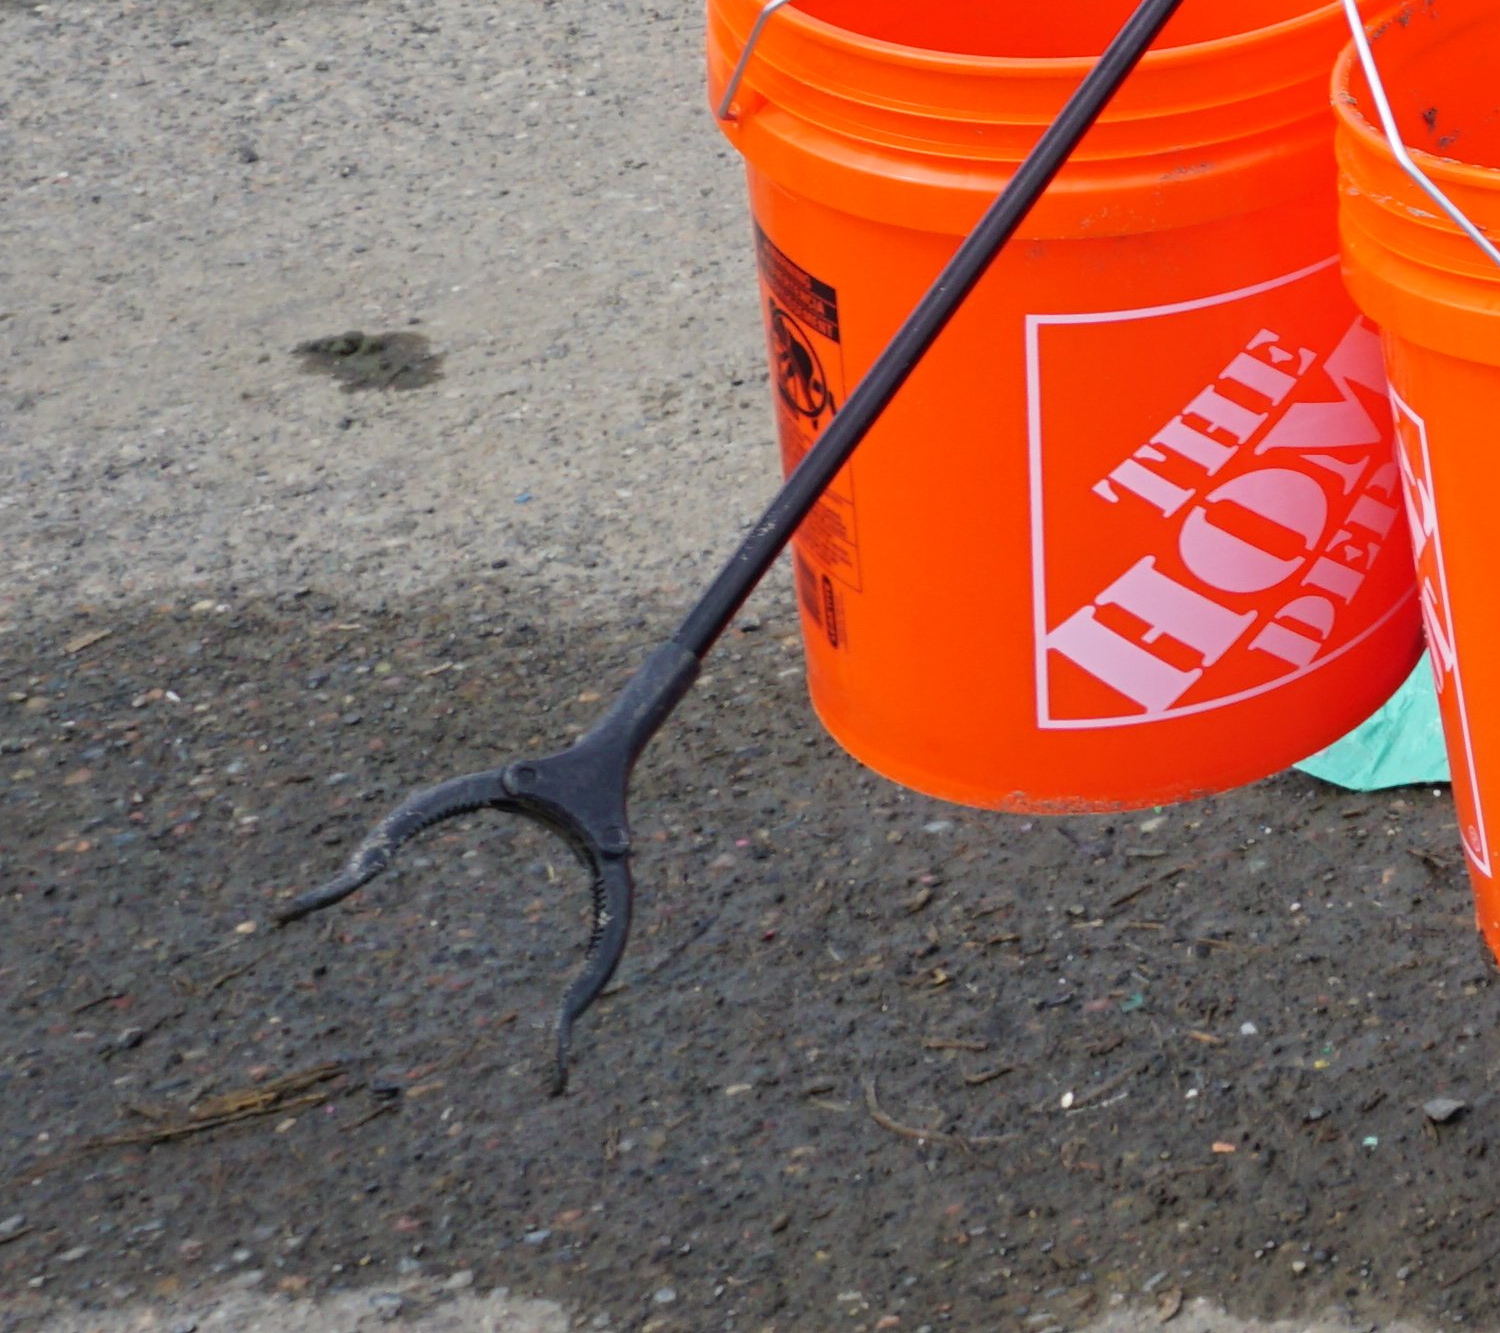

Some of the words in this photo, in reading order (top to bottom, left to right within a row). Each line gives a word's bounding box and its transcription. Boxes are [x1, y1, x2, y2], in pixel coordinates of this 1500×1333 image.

[1046, 314, 1391, 714] HOM
[1092, 328, 1317, 518] THE
[1248, 461, 1400, 668] DEP
